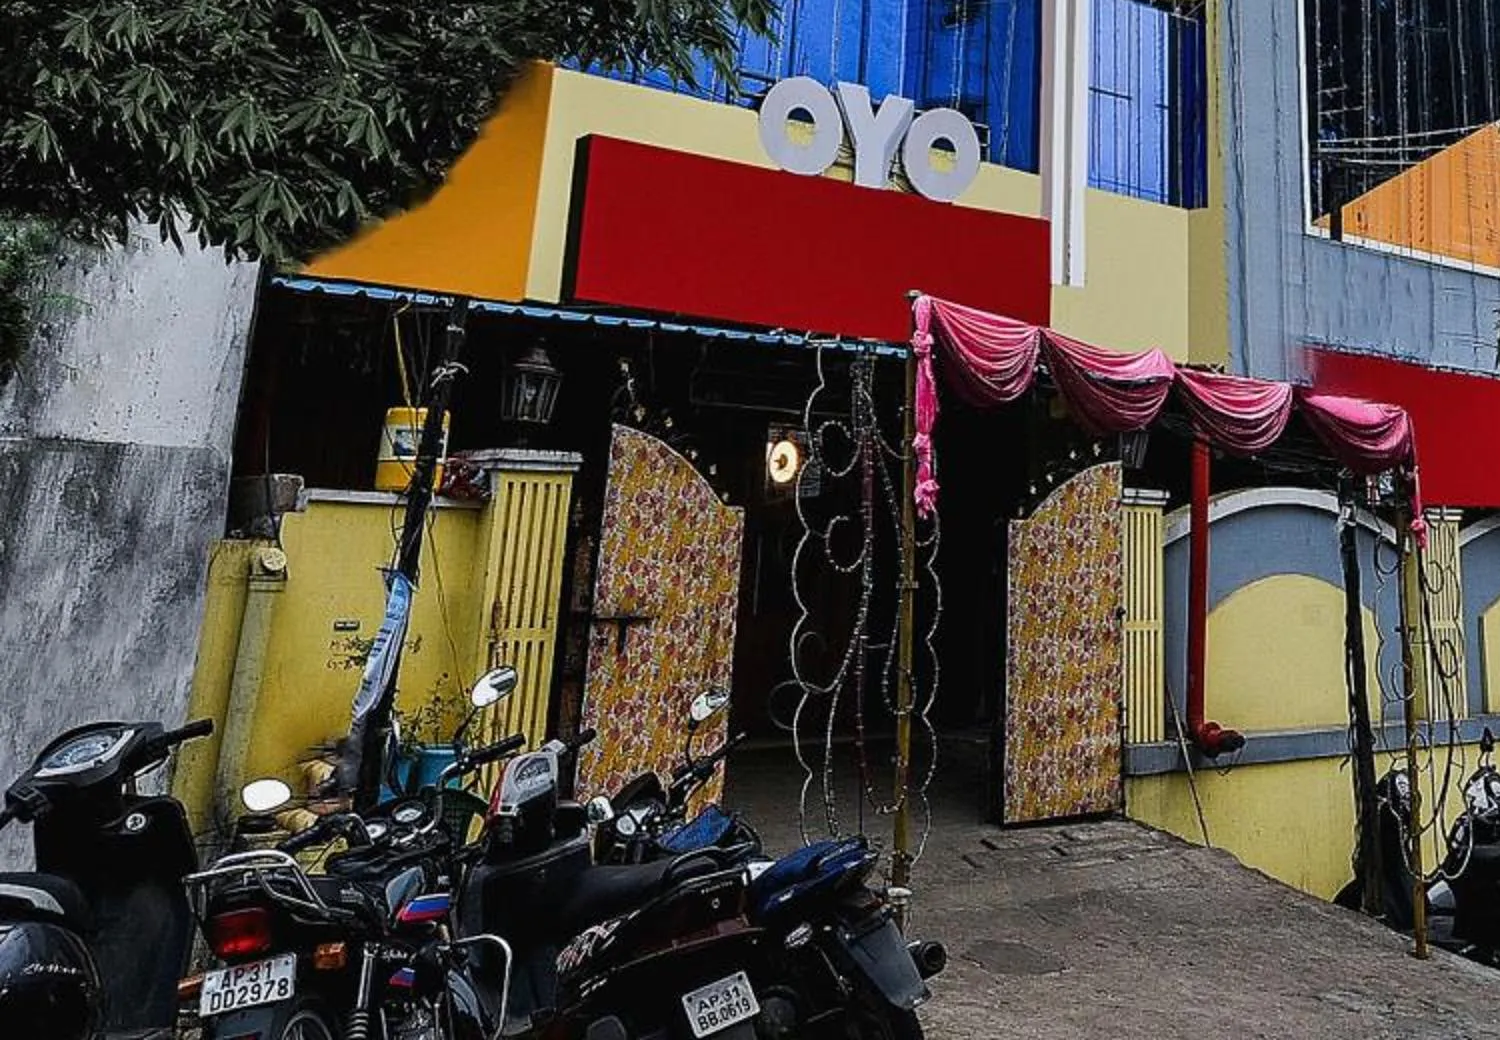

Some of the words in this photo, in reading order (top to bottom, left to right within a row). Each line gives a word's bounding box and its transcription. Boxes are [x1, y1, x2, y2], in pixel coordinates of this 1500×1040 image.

[758, 75, 982, 203] OYO
[220, 967, 245, 991] AP
[249, 960, 273, 983] 31
[209, 977, 290, 1013] DD2978
